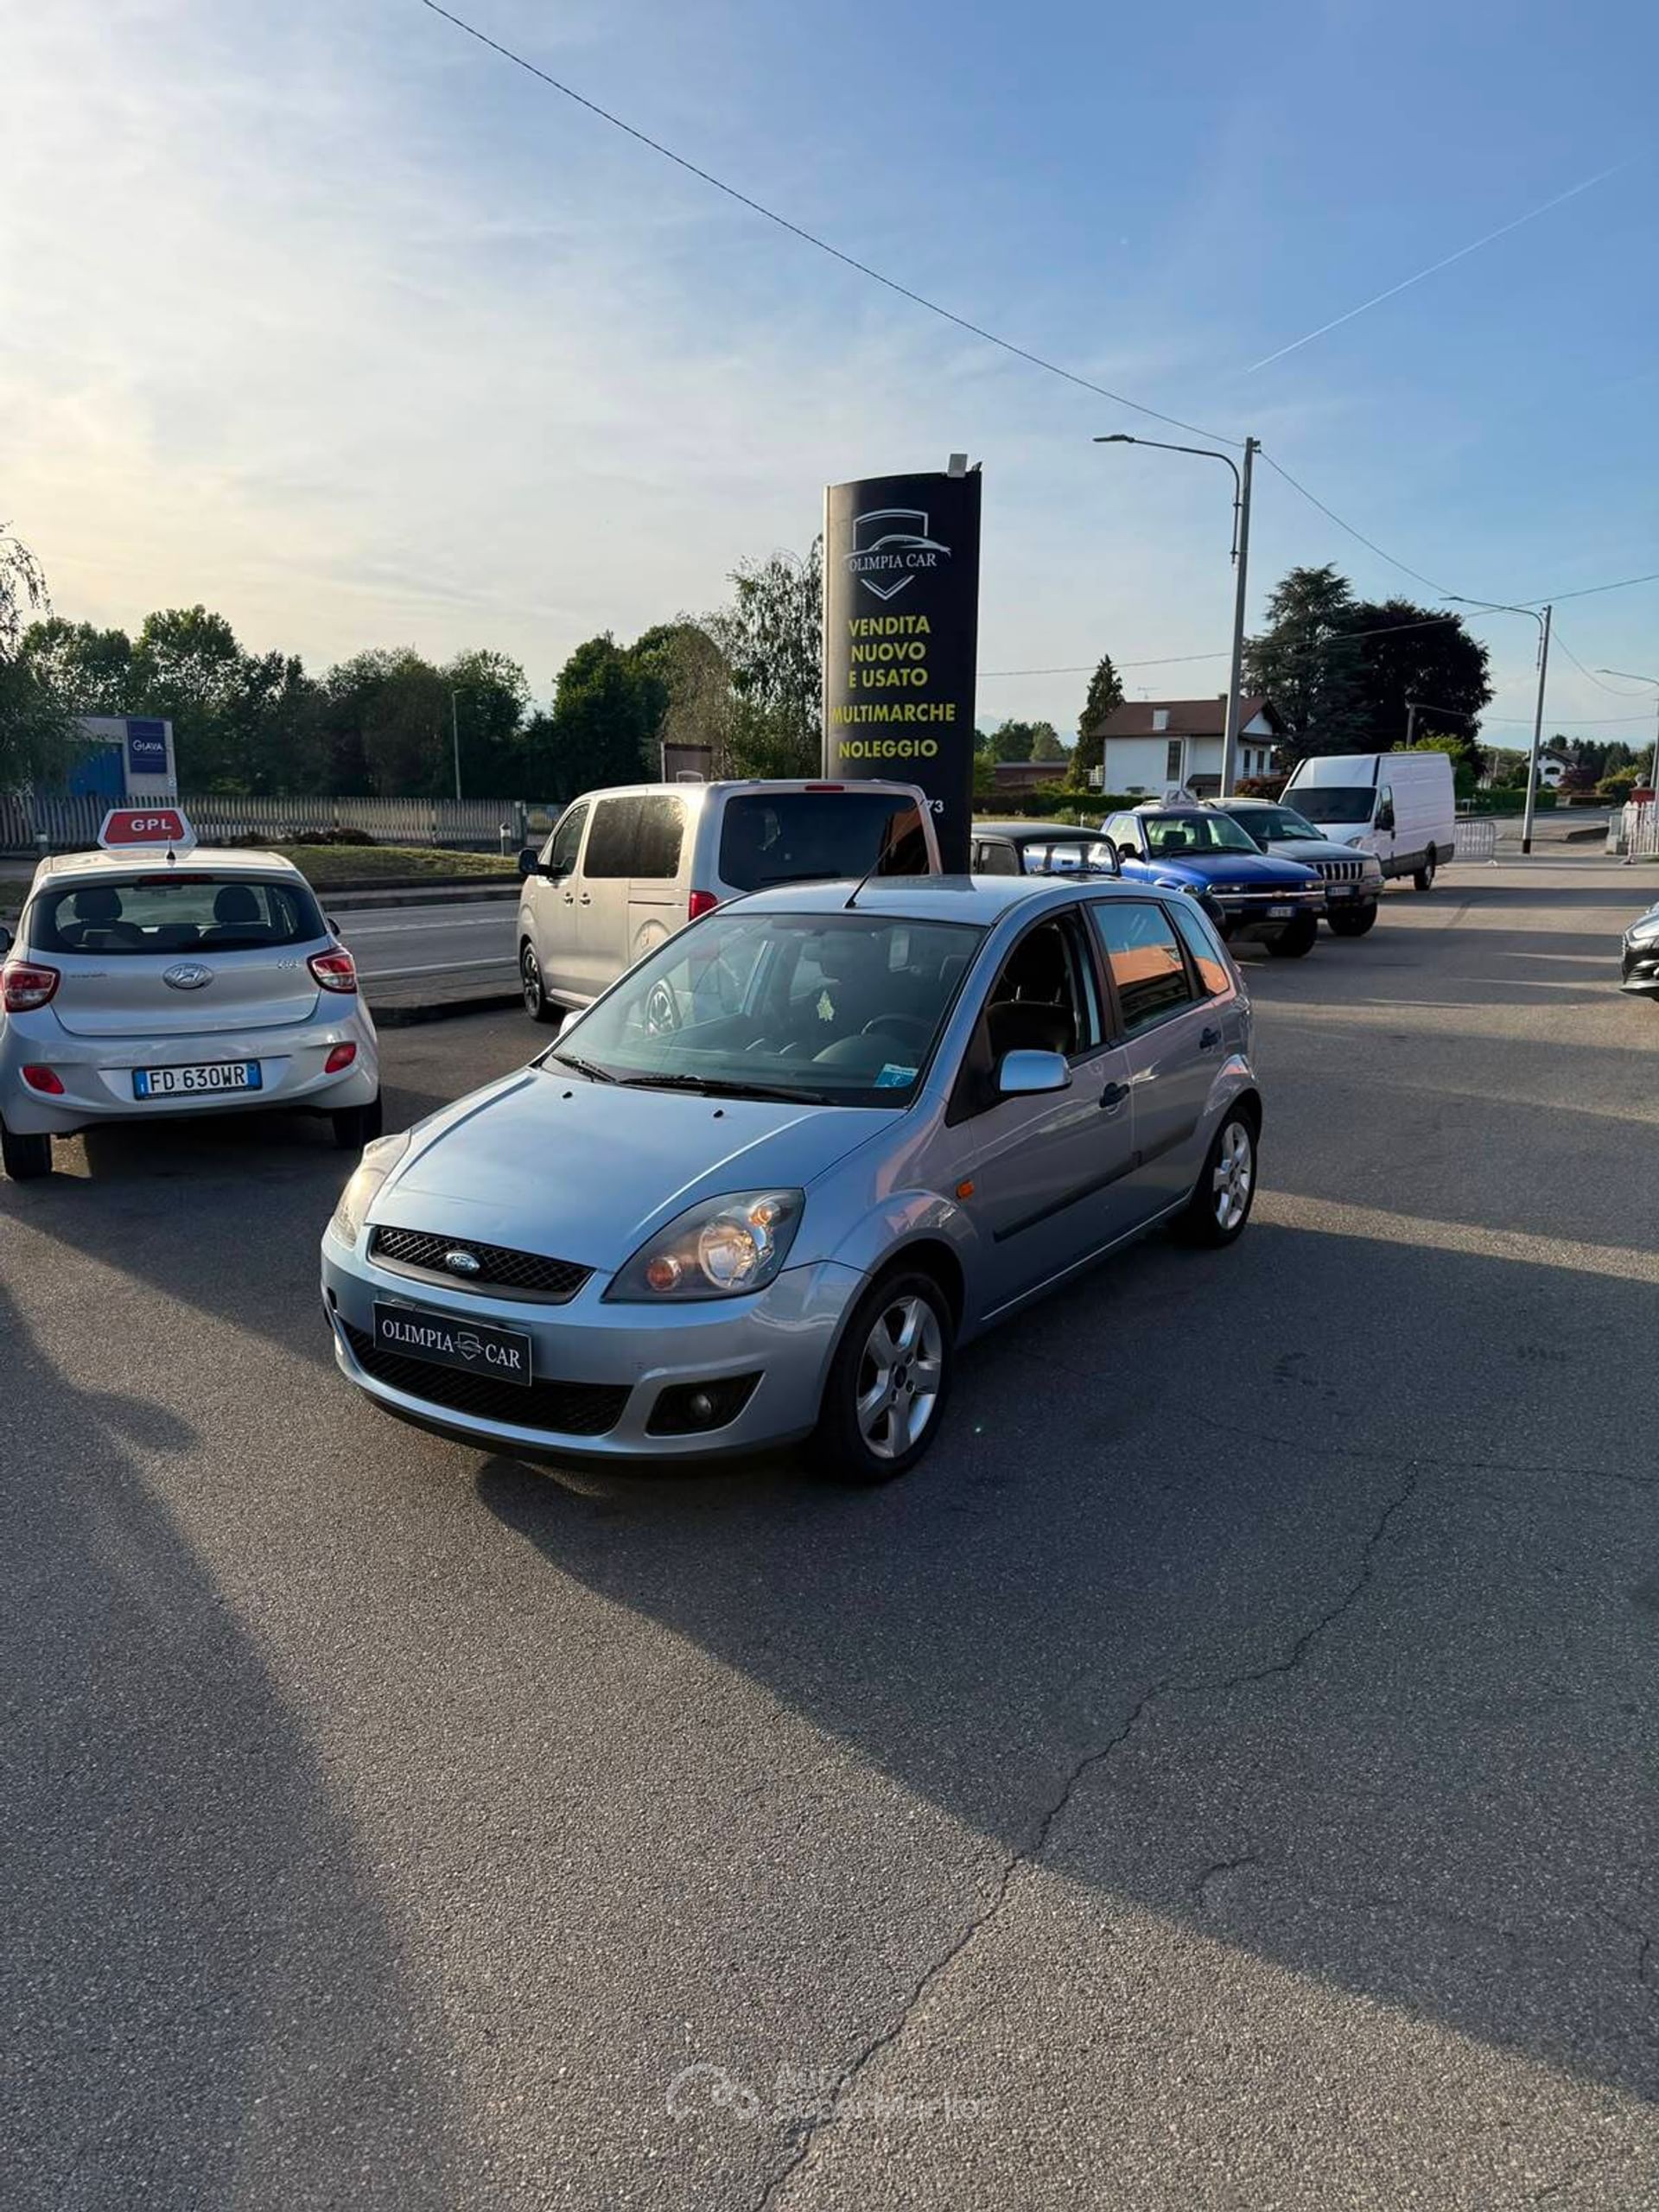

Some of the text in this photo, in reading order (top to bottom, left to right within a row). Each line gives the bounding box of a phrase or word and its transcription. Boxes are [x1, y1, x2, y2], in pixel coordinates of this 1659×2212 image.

[849, 553, 938, 572] OLIMPIA CAR
[849, 615, 931, 637] VENDITA
[851, 641, 926, 663] NUOVO
[849, 667, 929, 689] E USATO
[830, 703, 957, 724] MULTIMARCHE
[839, 739, 939, 759] NOLEGGIO
[130, 818, 173, 831] GPL
[149, 1071, 175, 1091] FD
[182, 1065, 245, 1089] 630WR
[381, 1319, 521, 1370] OLIMPIA CAR
